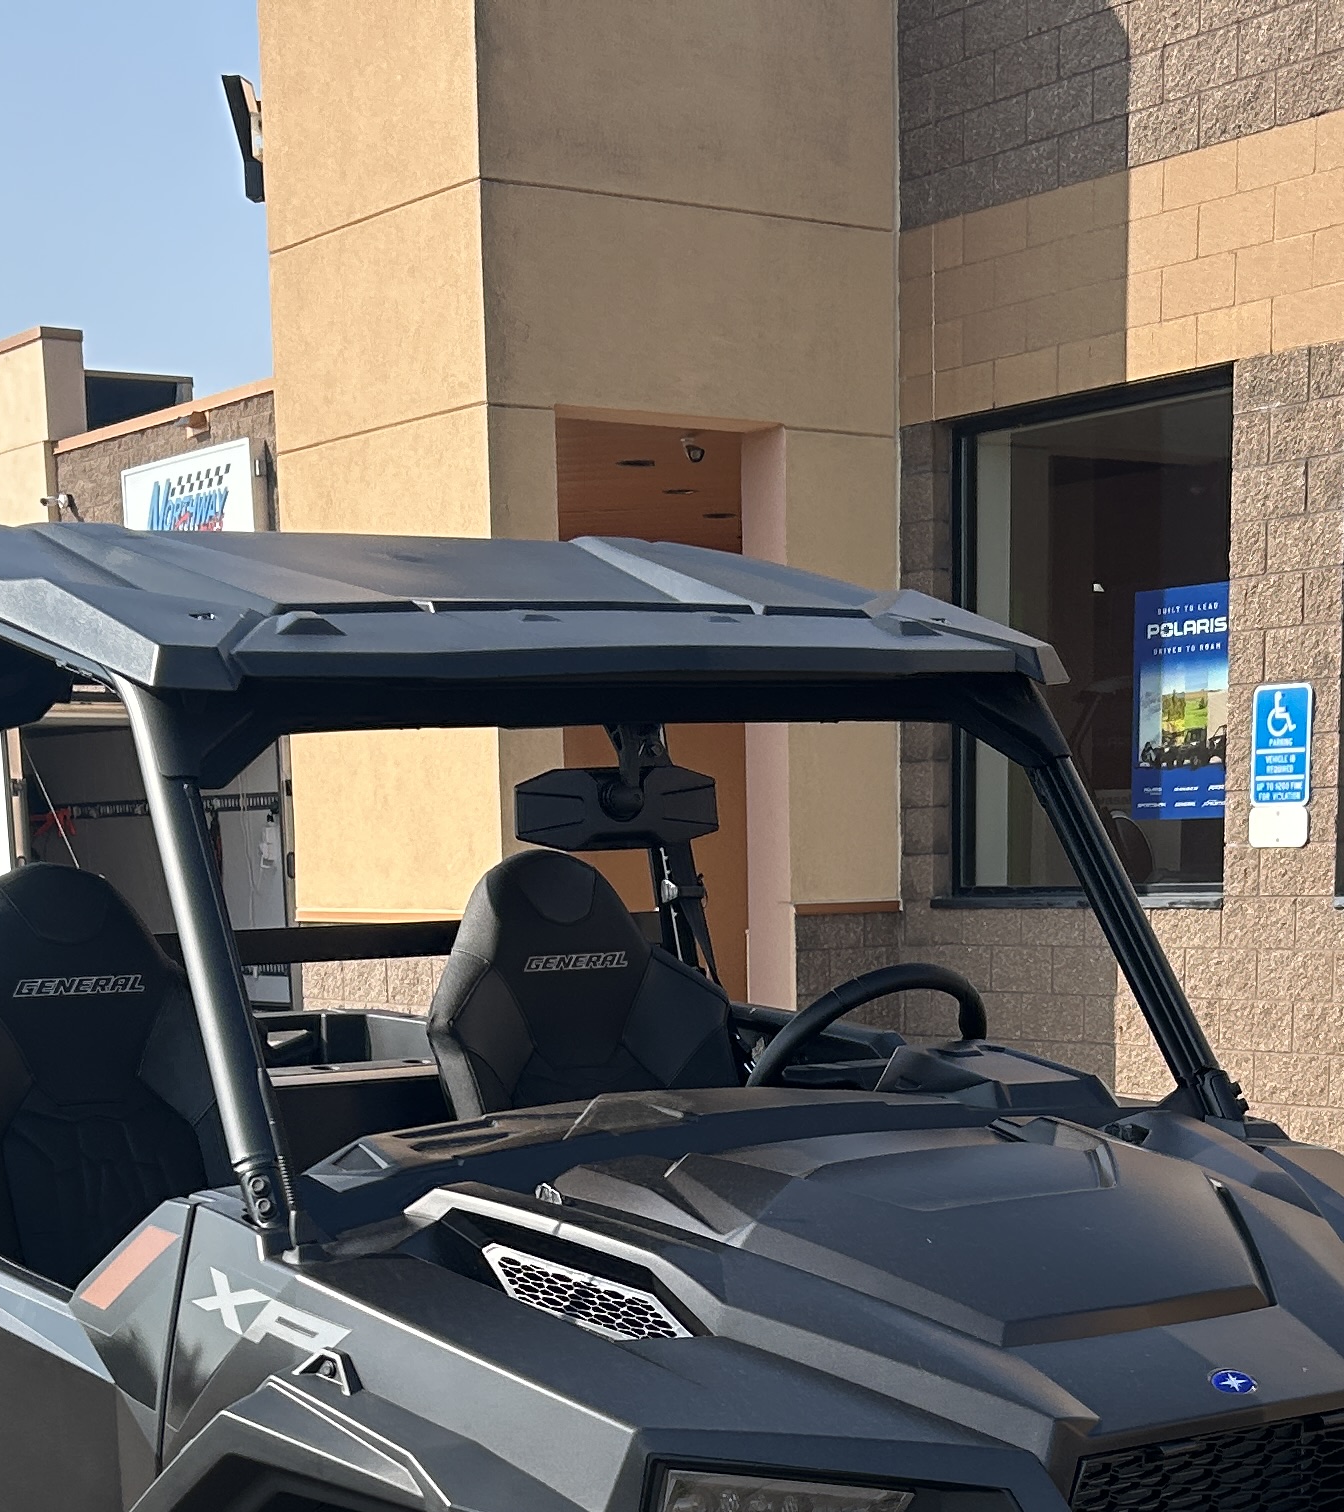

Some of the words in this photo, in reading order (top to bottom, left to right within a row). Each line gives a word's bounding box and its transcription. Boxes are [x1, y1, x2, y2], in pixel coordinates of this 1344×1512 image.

[147, 478, 229, 531] NORTHWAY
[1157, 605, 1181, 616] BUILT
[1184, 604, 1194, 613] TO
[1197, 601, 1219, 611] LEAD
[1146, 616, 1228, 640] POLARIS
[1153, 646, 1182, 656] DRIVEN
[1185, 644, 1196, 653] TO
[1199, 642, 1221, 652] ROAM
[1268, 737, 1294, 747] PARKING
[523, 950, 628, 973] GENERAL
[12, 974, 147, 998] GENERAL
[191, 1266, 353, 1354] XP
